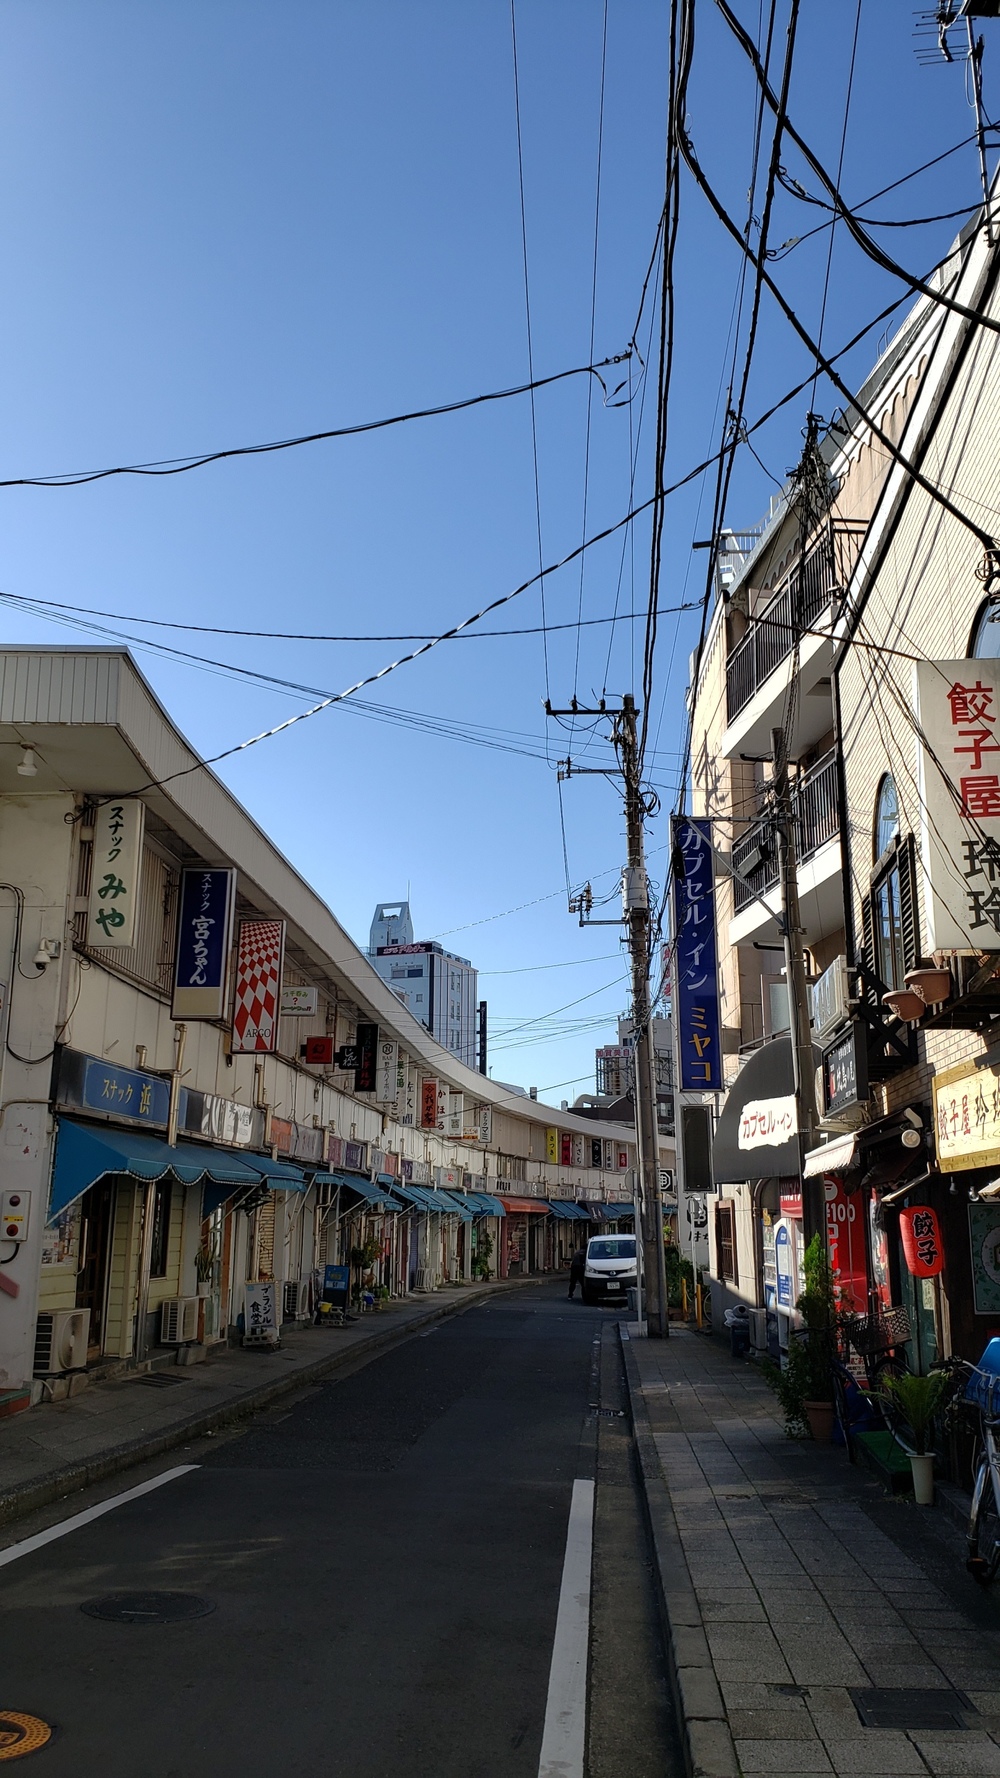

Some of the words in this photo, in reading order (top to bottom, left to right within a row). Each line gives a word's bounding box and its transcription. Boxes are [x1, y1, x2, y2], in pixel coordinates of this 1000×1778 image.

[946, 680, 1000, 818] 餃子屋
[108, 806, 124, 863] スナック
[96, 873, 127, 937] みや
[200, 873, 212, 912] スナック
[681, 828, 708, 990] カプセル・イン
[189, 915, 216, 985] 宮ちゃん
[245, 1029, 271, 1038] ARGO
[688, 1007, 711, 1082] ミヤコ
[101, 1078, 134, 1104] スナック
[139, 1083, 152, 1116] 浜
[743, 1110, 793, 1139] カプセル・イン
[912, 1210, 938, 1267] 餃子
[250, 1301, 262, 1325] 食堂
[261, 1285, 272, 1323] ブラジル
